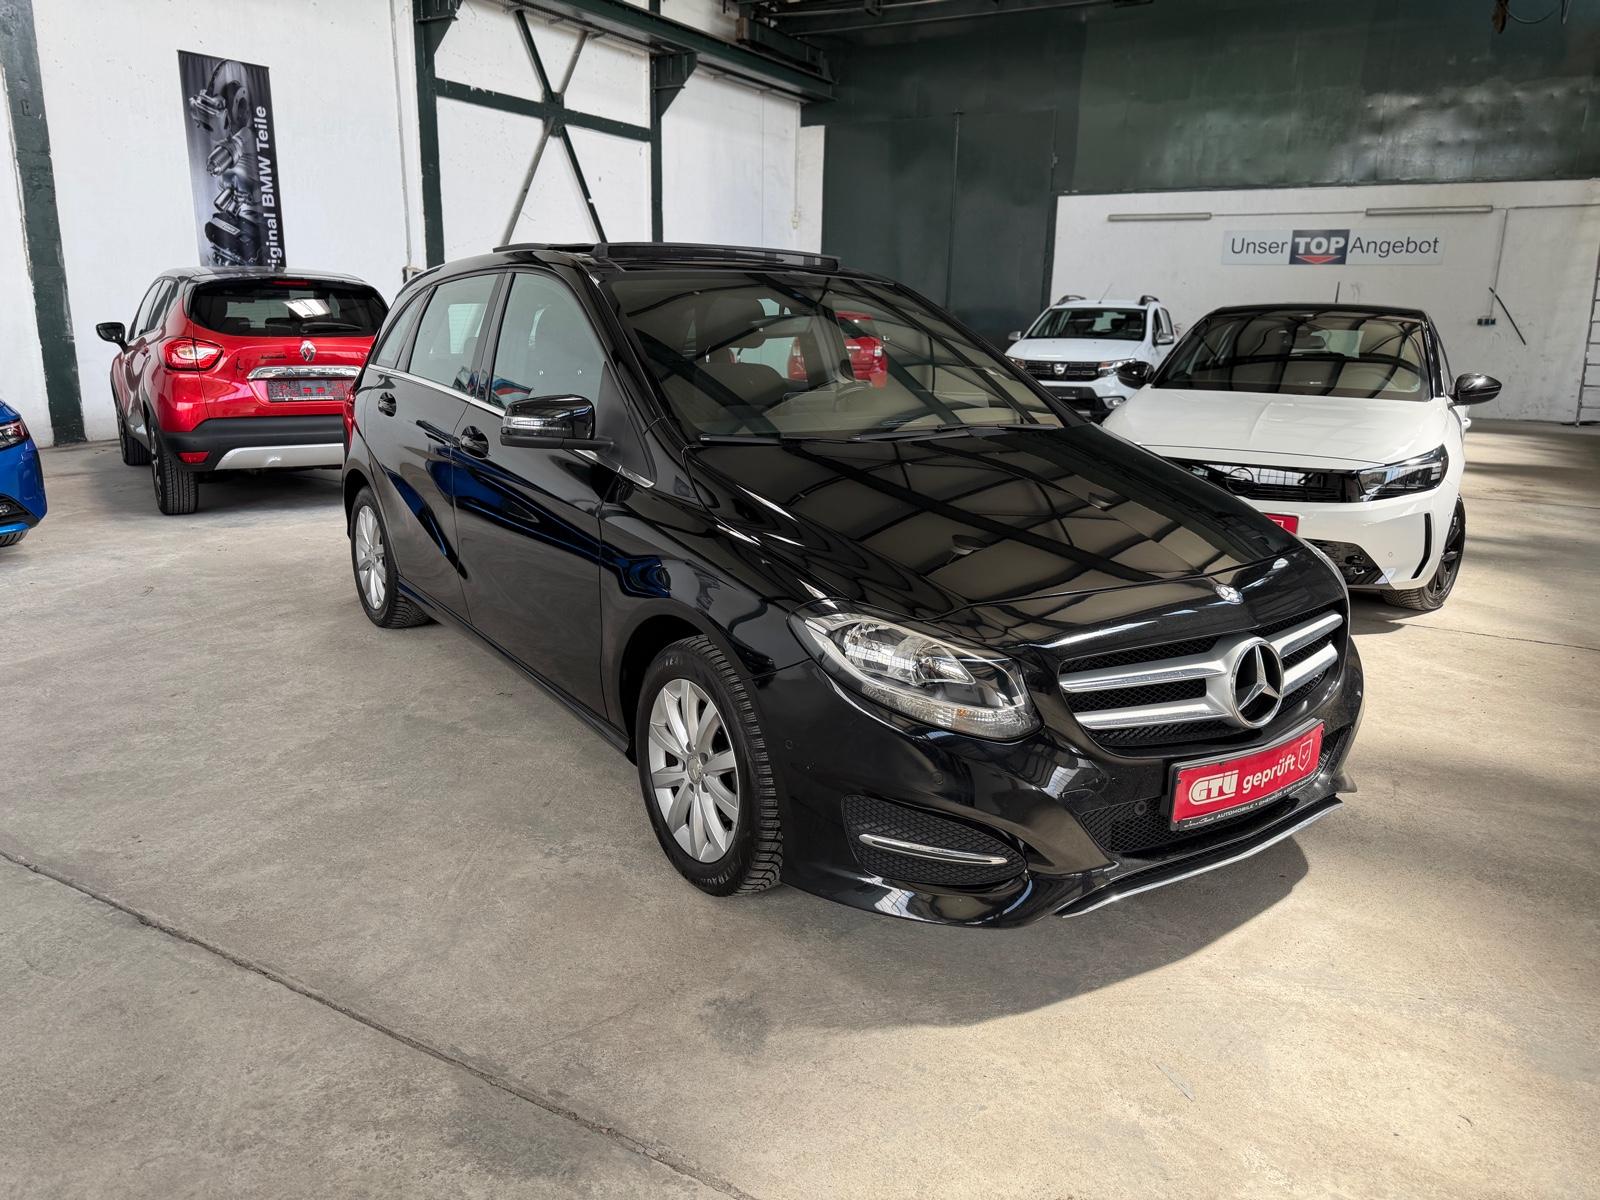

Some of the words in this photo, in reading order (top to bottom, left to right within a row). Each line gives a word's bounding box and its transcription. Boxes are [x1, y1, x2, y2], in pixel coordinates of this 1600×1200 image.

[254, 105, 270, 150] Teile
[257, 156, 275, 208] BMW
[1231, 238, 1288, 254] Unser
[1295, 237, 1346, 254] TOP
[1349, 237, 1440, 258] Angebot
[1242, 754, 1297, 794] geprüft
[1216, 804, 1254, 819] AUTOMOBILE
